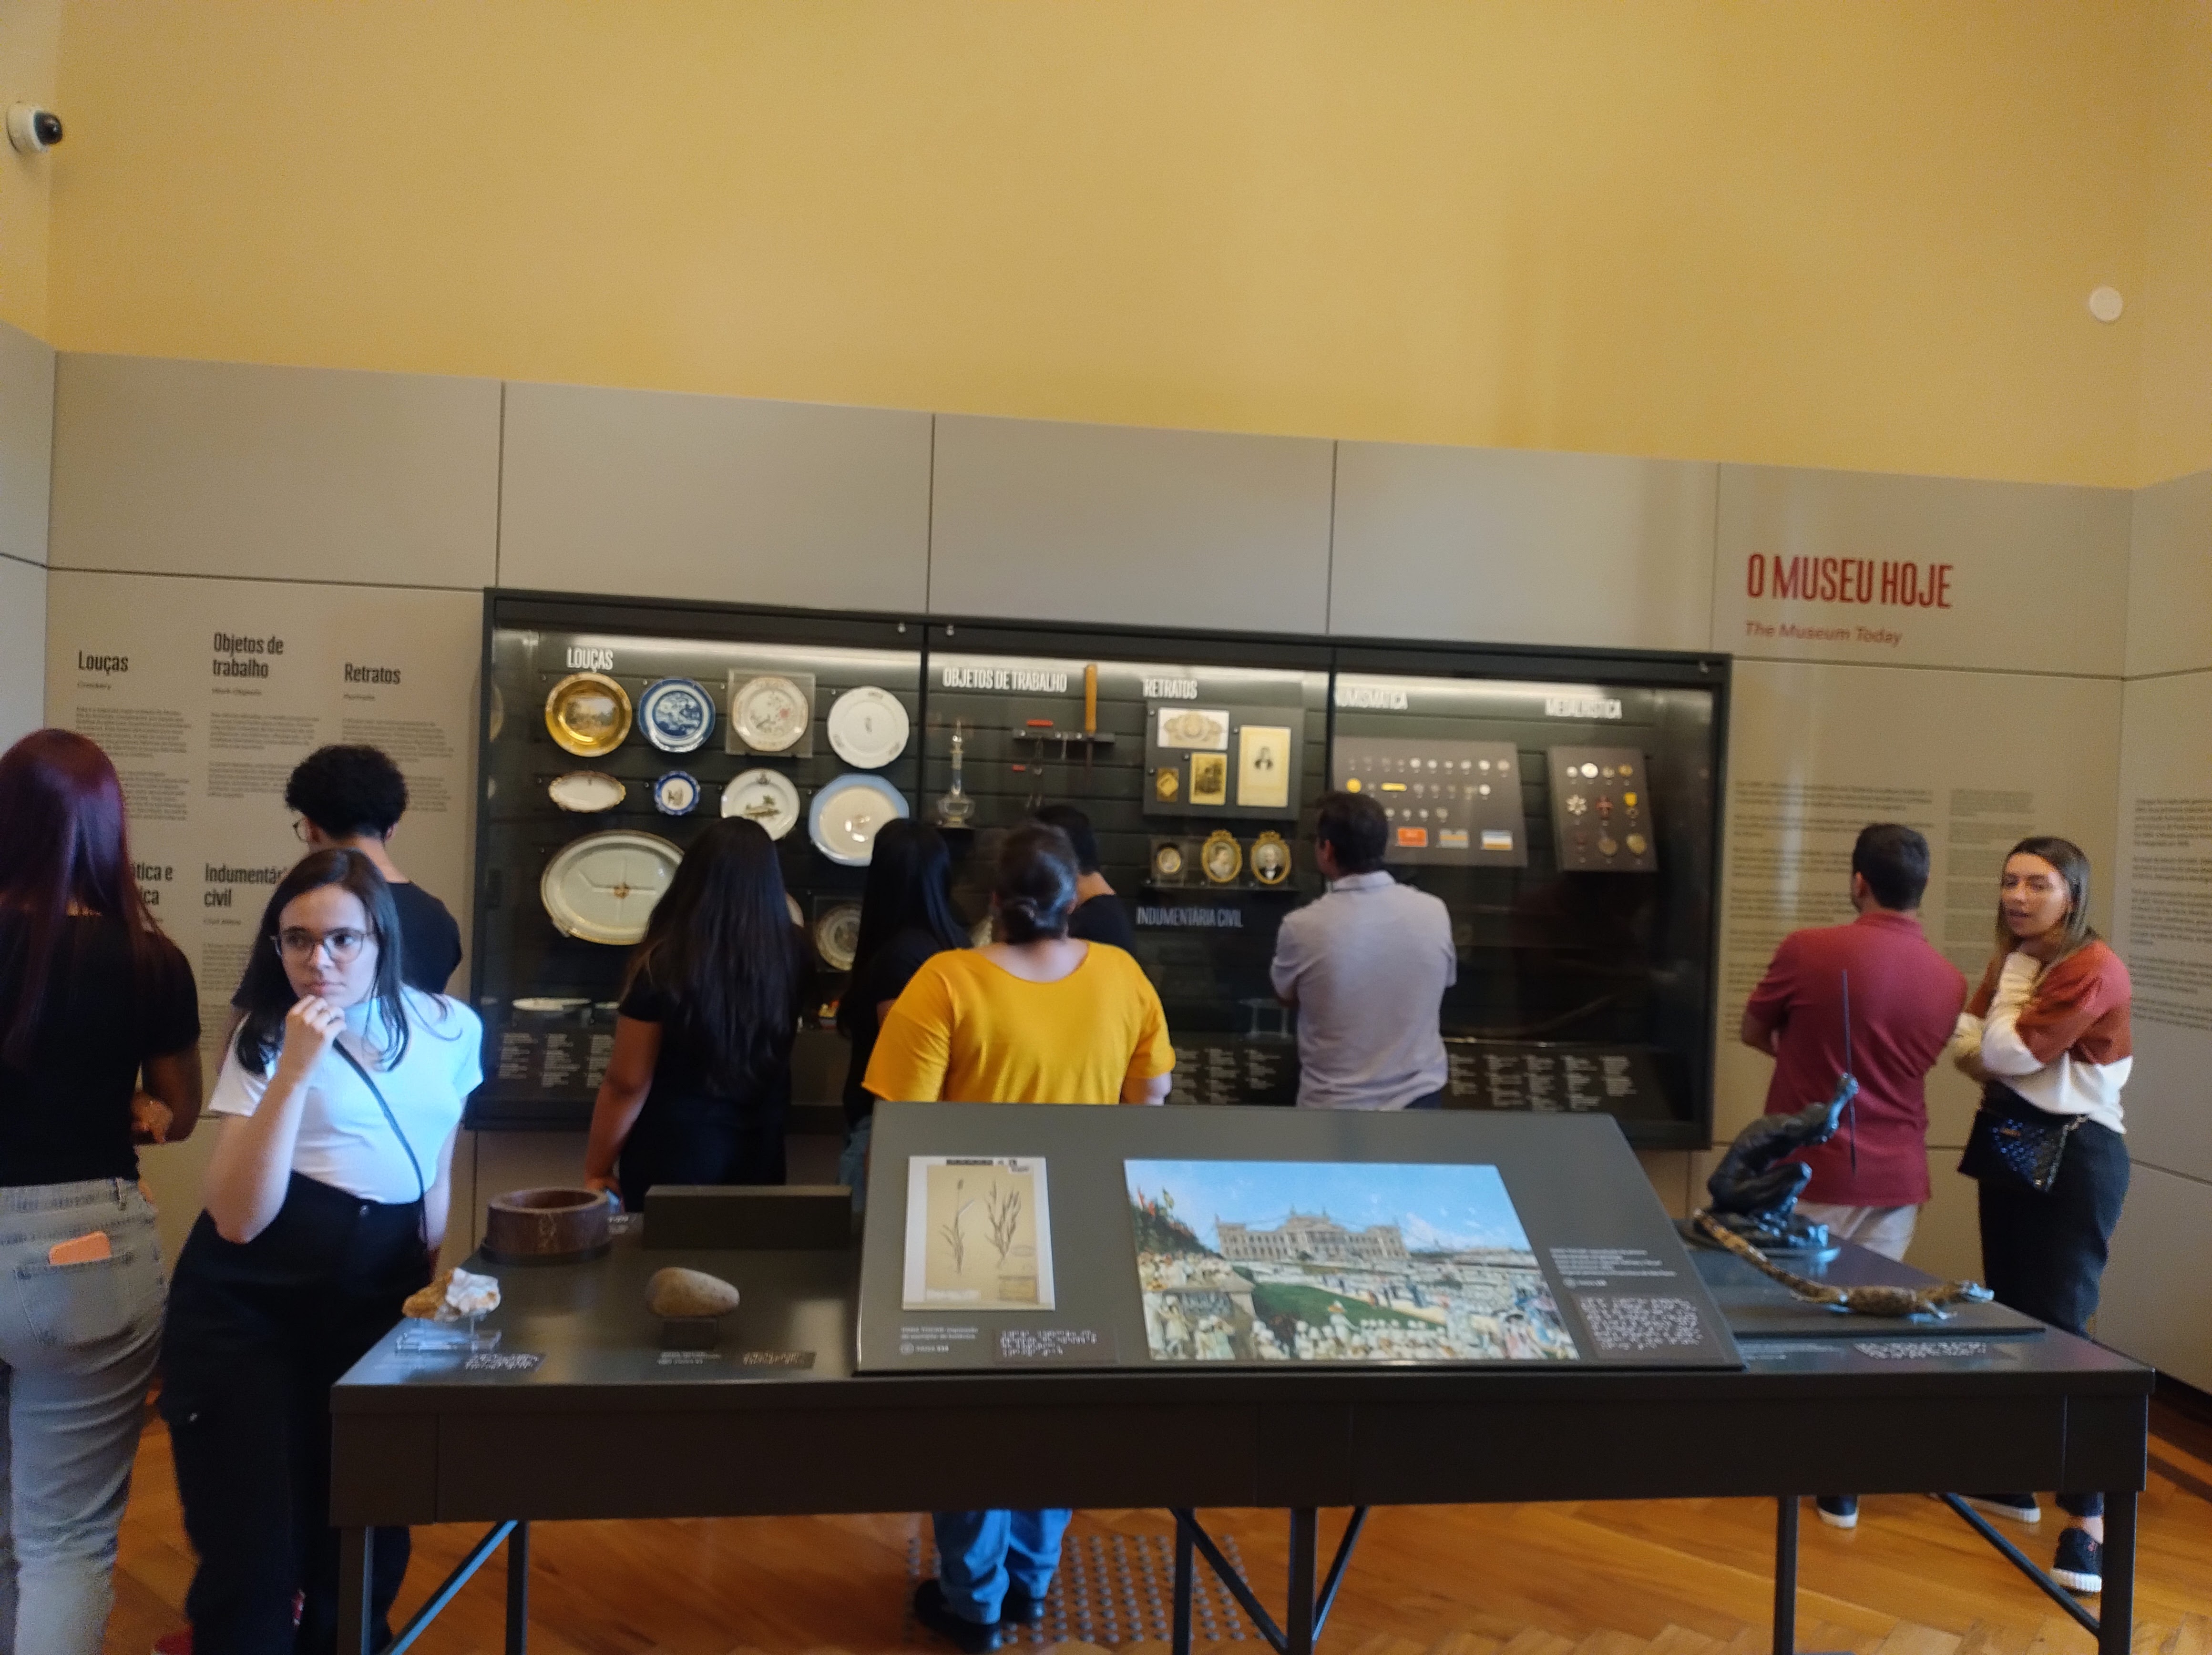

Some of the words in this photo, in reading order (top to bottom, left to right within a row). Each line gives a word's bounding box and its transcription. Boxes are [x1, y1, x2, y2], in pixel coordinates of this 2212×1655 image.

[1747, 553, 1765, 598] O
[1772, 555, 1874, 603] MUSEU
[1880, 561, 1954, 609] HOJE
[214, 632, 265, 657] Objetos
[267, 633, 284, 655] de
[1745, 621, 1774, 637] The
[1779, 623, 1851, 641] Museum
[1856, 625, 1903, 648] Today
[78, 649, 129, 675] Louças
[212, 657, 269, 679] trabalho
[566, 647, 613, 673] LOUÇAS
[344, 662, 401, 684] Retratos
[942, 667, 993, 689] OBJETOS
[994, 670, 1010, 690] DE
[1011, 671, 1068, 693] TRABALHO
[1142, 678, 1198, 700] RETRATOS
[205, 862, 287, 885] Indumentár
[204, 888, 232, 908] civil
